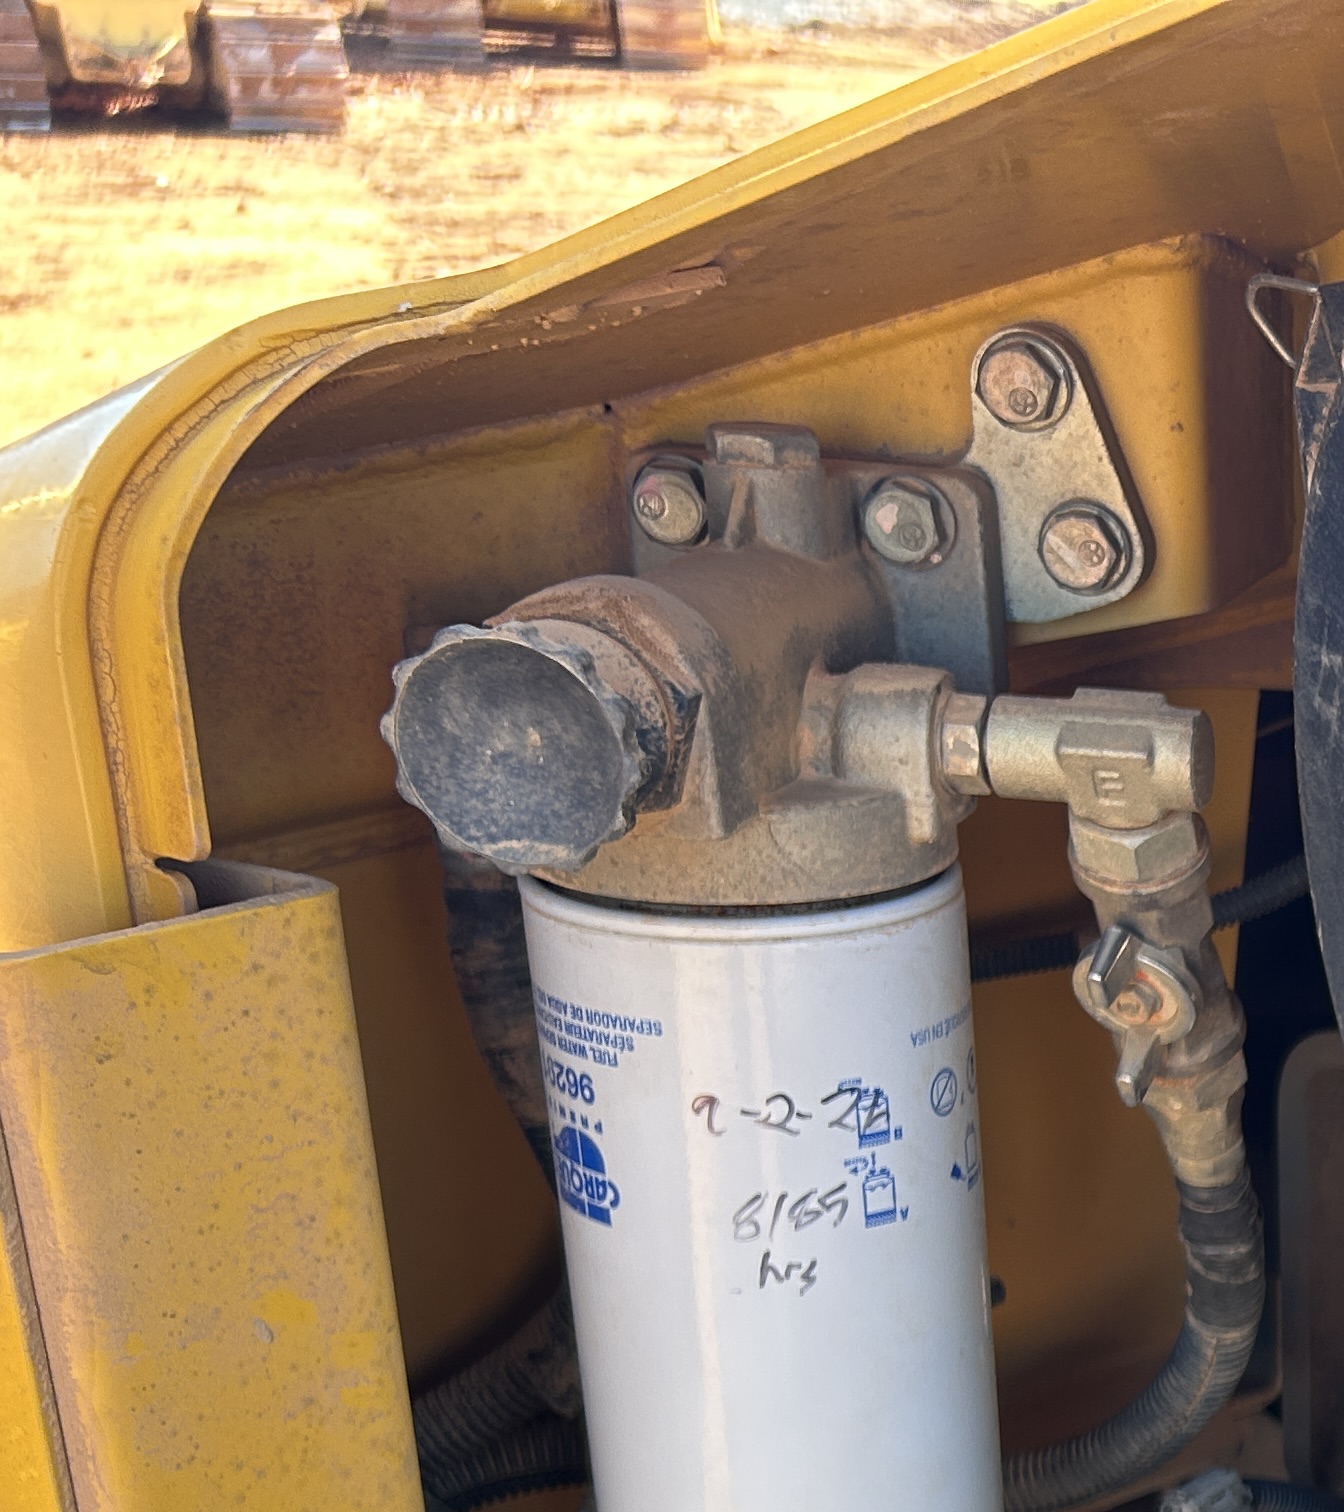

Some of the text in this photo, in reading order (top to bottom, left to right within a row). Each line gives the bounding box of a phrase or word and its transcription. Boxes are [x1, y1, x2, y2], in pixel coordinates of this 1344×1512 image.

[590, 1046, 618, 1067] FUEL
[557, 1154, 620, 1209] CARQU
[759, 1250, 817, 1297] hrs
